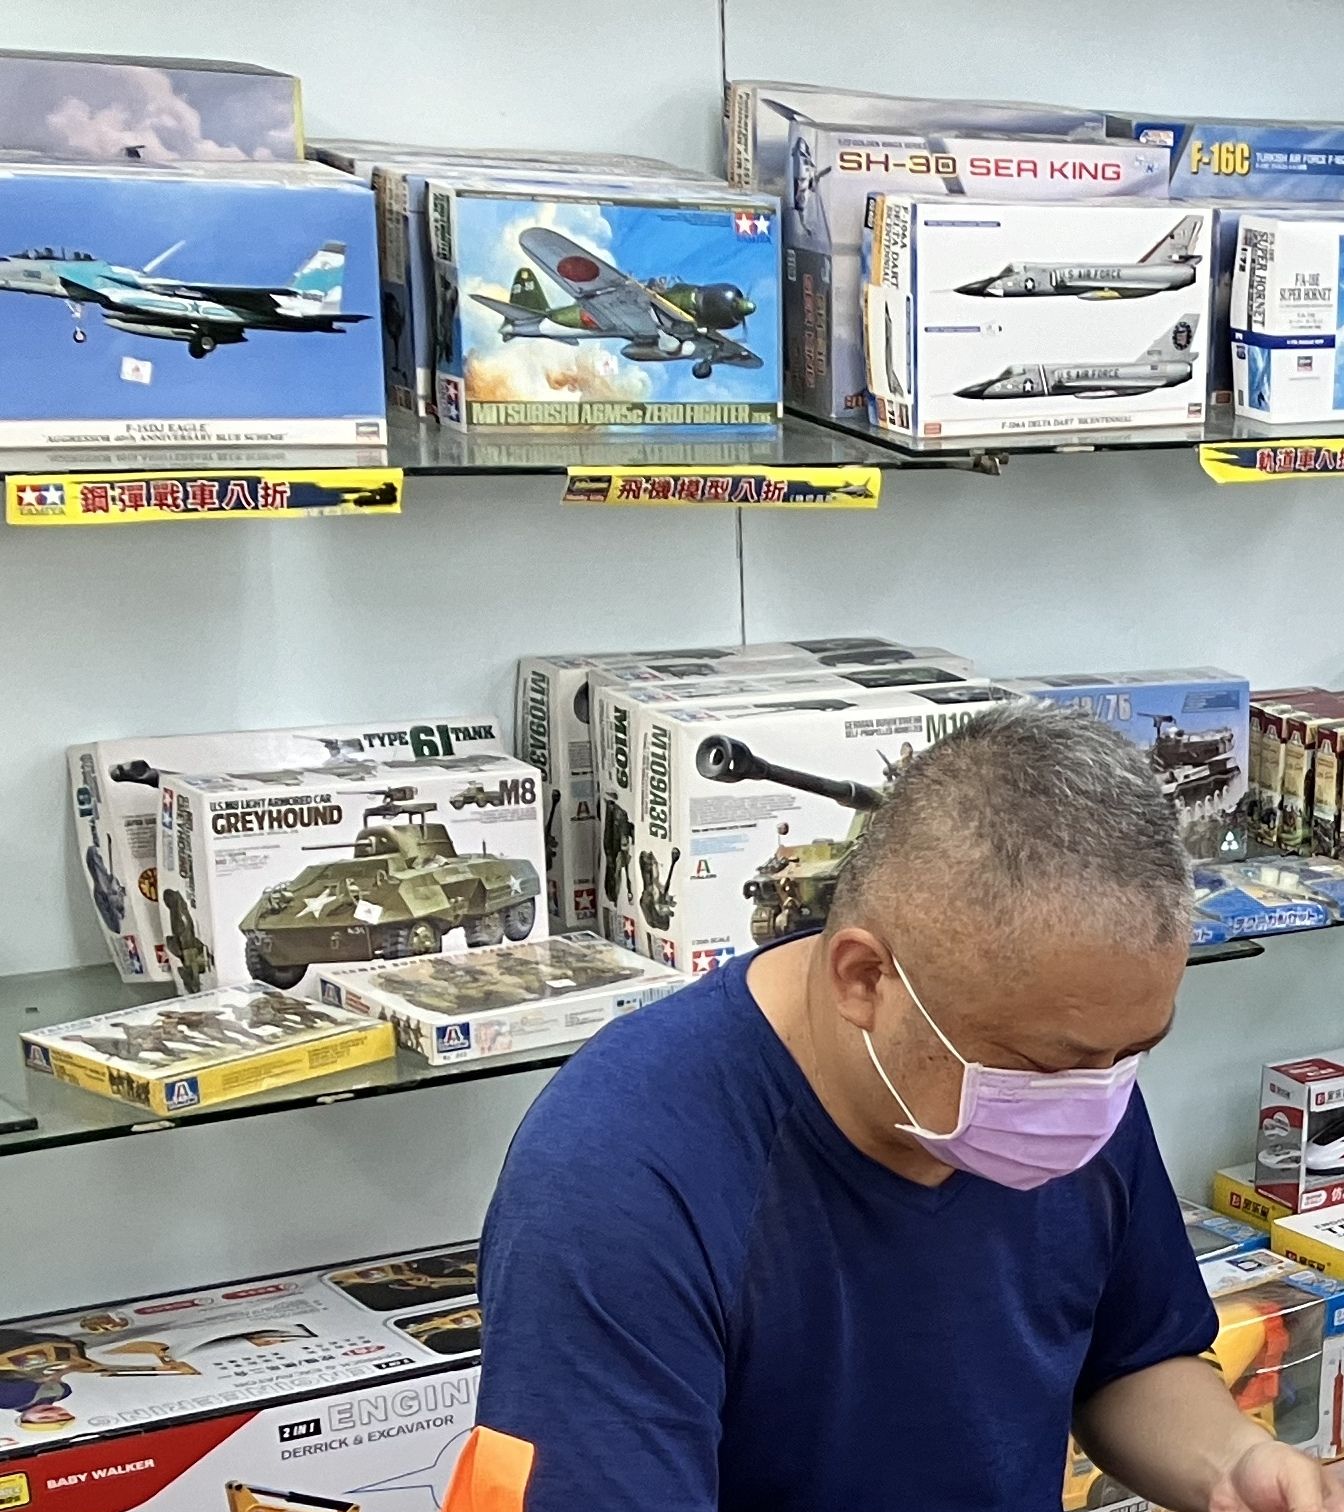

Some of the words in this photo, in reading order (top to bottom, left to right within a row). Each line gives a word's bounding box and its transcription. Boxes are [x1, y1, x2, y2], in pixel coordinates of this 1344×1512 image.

[839, 151, 957, 175] SH-3D
[969, 158, 1038, 178] SEA
[1049, 161, 1121, 181] KING
[1190, 140, 1251, 176] F-16C
[892, 205, 900, 246] DELTA
[1255, 231, 1268, 271] SUPER
[891, 251, 900, 290] DART
[1095, 267, 1122, 280] FORCE
[1253, 275, 1266, 328] HORNET
[1279, 287, 1302, 302] SUPER
[1303, 287, 1332, 302] HORNET
[1092, 366, 1120, 380] FORCE
[168, 422, 208, 433] EAGLE
[472, 403, 579, 424] MITSUBISHI
[580, 404, 643, 424] A6M5c
[643, 404, 684, 424] ZERO
[685, 404, 750, 424] FIGHTER
[1028, 419, 1052, 428] DELTA
[1053, 418, 1075, 428] DART
[140, 431, 213, 442] ANNIVERSARY
[215, 431, 242, 441] BLUE
[80, 478, 290, 514] 鋼彈戰車八折
[617, 477, 788, 503] 飛機模型八折
[363, 730, 409, 748] TYPE
[409, 725, 455, 760] 61
[451, 725, 496, 743] TANK
[614, 705, 629, 789] M109
[499, 777, 537, 807] M8
[649, 724, 667, 840] M109A3G
[241, 798, 266, 809] LIGHT
[267, 795, 313, 807] ARMORED
[314, 793, 332, 805] CAR
[211, 804, 343, 836] GREYHOUND
[281, 1437, 349, 1461] DERRICK
[353, 1434, 363, 1446] &
[367, 1414, 455, 1443] EXCAVATOR
[292, 1424, 307, 1437] IN
[47, 1472, 88, 1490] BABY
[91, 1458, 156, 1481] WALKER
